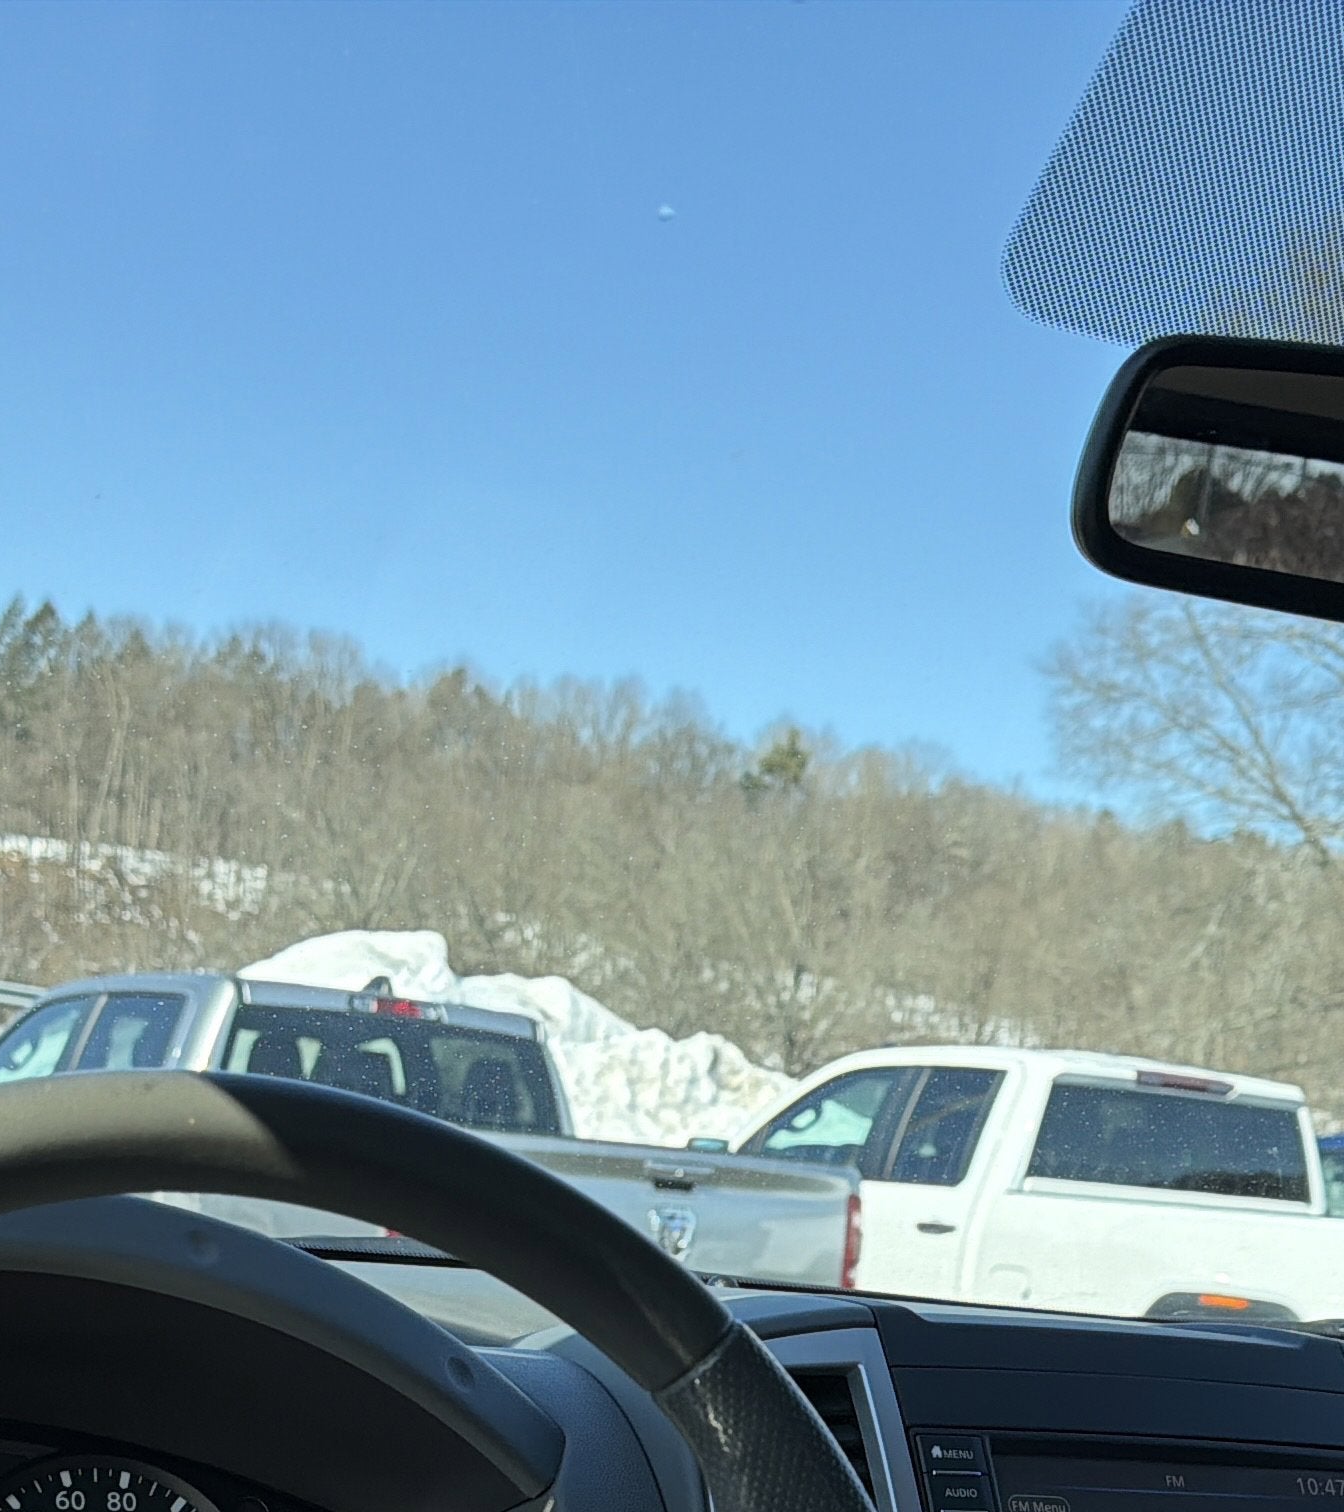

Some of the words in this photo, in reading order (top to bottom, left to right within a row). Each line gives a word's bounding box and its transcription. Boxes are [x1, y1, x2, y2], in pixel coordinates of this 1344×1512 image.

[943, 1449, 974, 1460] MENU
[1165, 1475, 1185, 1488] FM
[945, 1487, 978, 1498] AUDIO
[55, 1490, 86, 1511] 60
[106, 1491, 136, 1512] 80
[1011, 1500, 1030, 1512] FM
